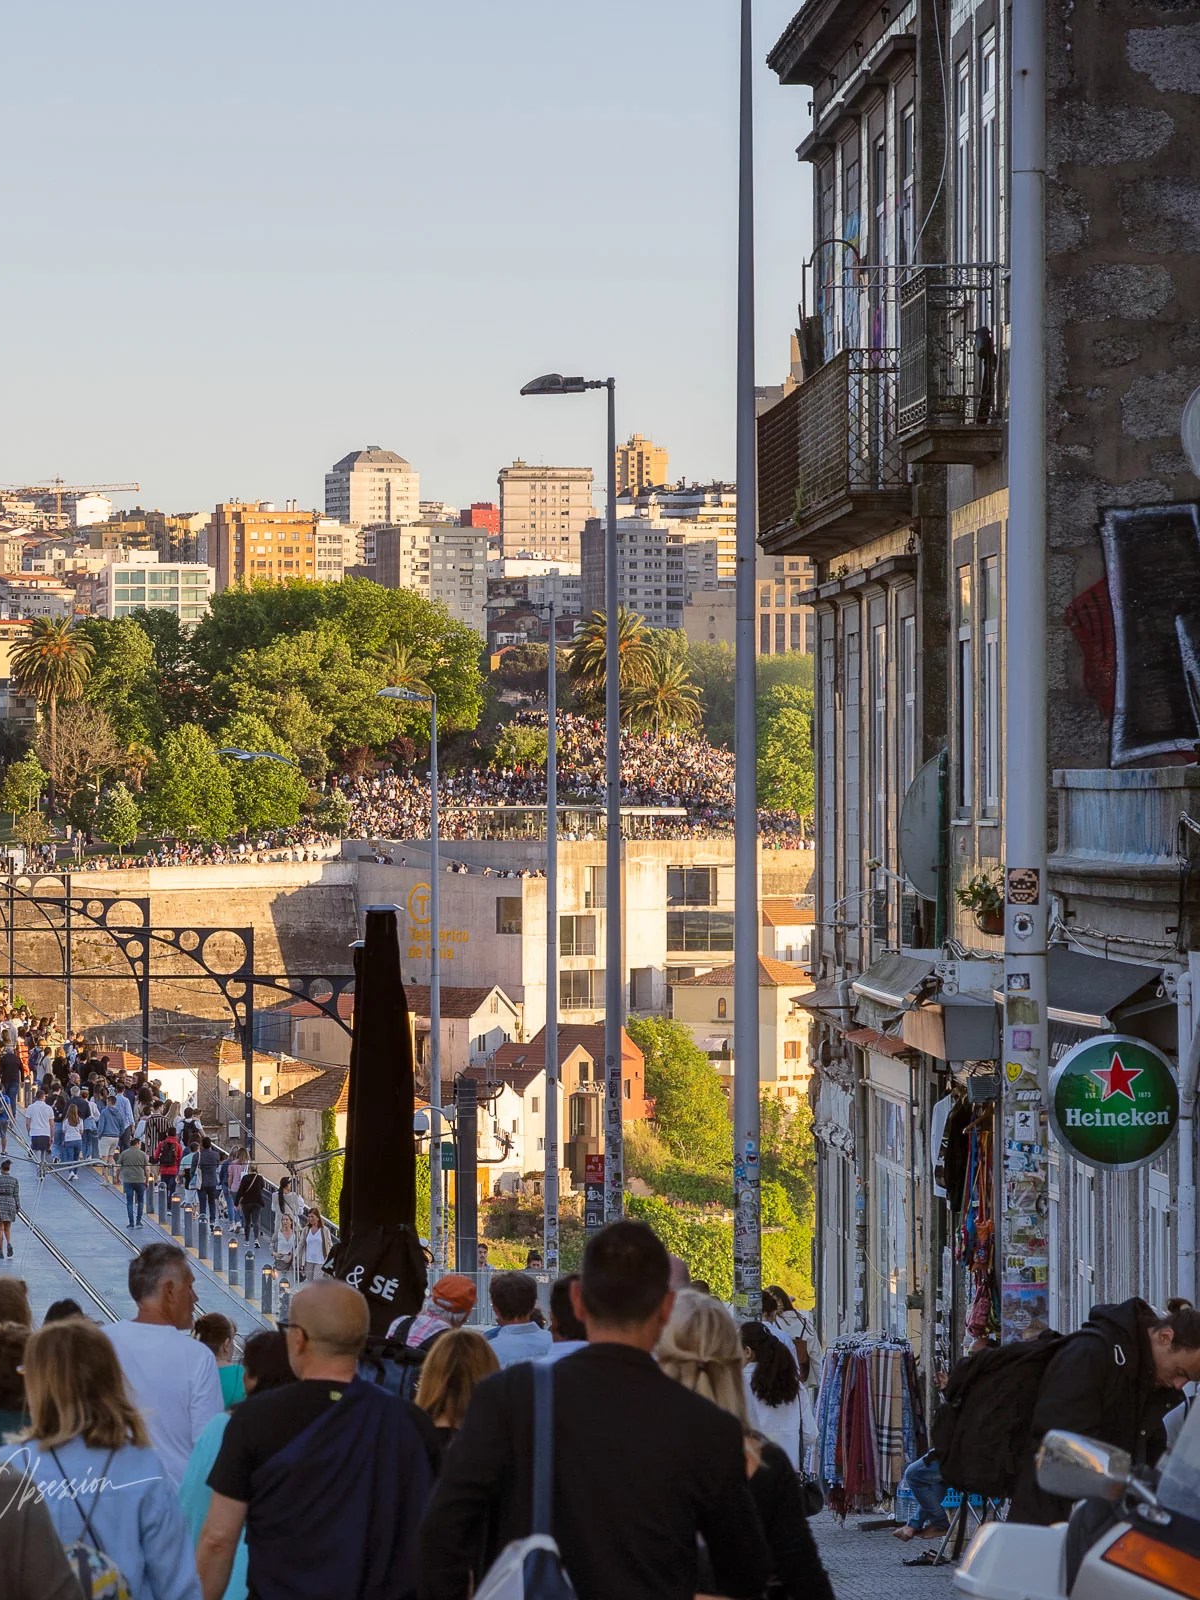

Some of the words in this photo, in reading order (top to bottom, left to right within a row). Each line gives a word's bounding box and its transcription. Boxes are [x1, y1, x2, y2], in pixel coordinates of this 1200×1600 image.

[408, 926, 469, 942] Teleérico
[408, 945, 423, 958] de
[1065, 1108, 1170, 1127] Heineken
[345, 1265, 365, 1289] &
[369, 1274, 399, 1302] SÉ
